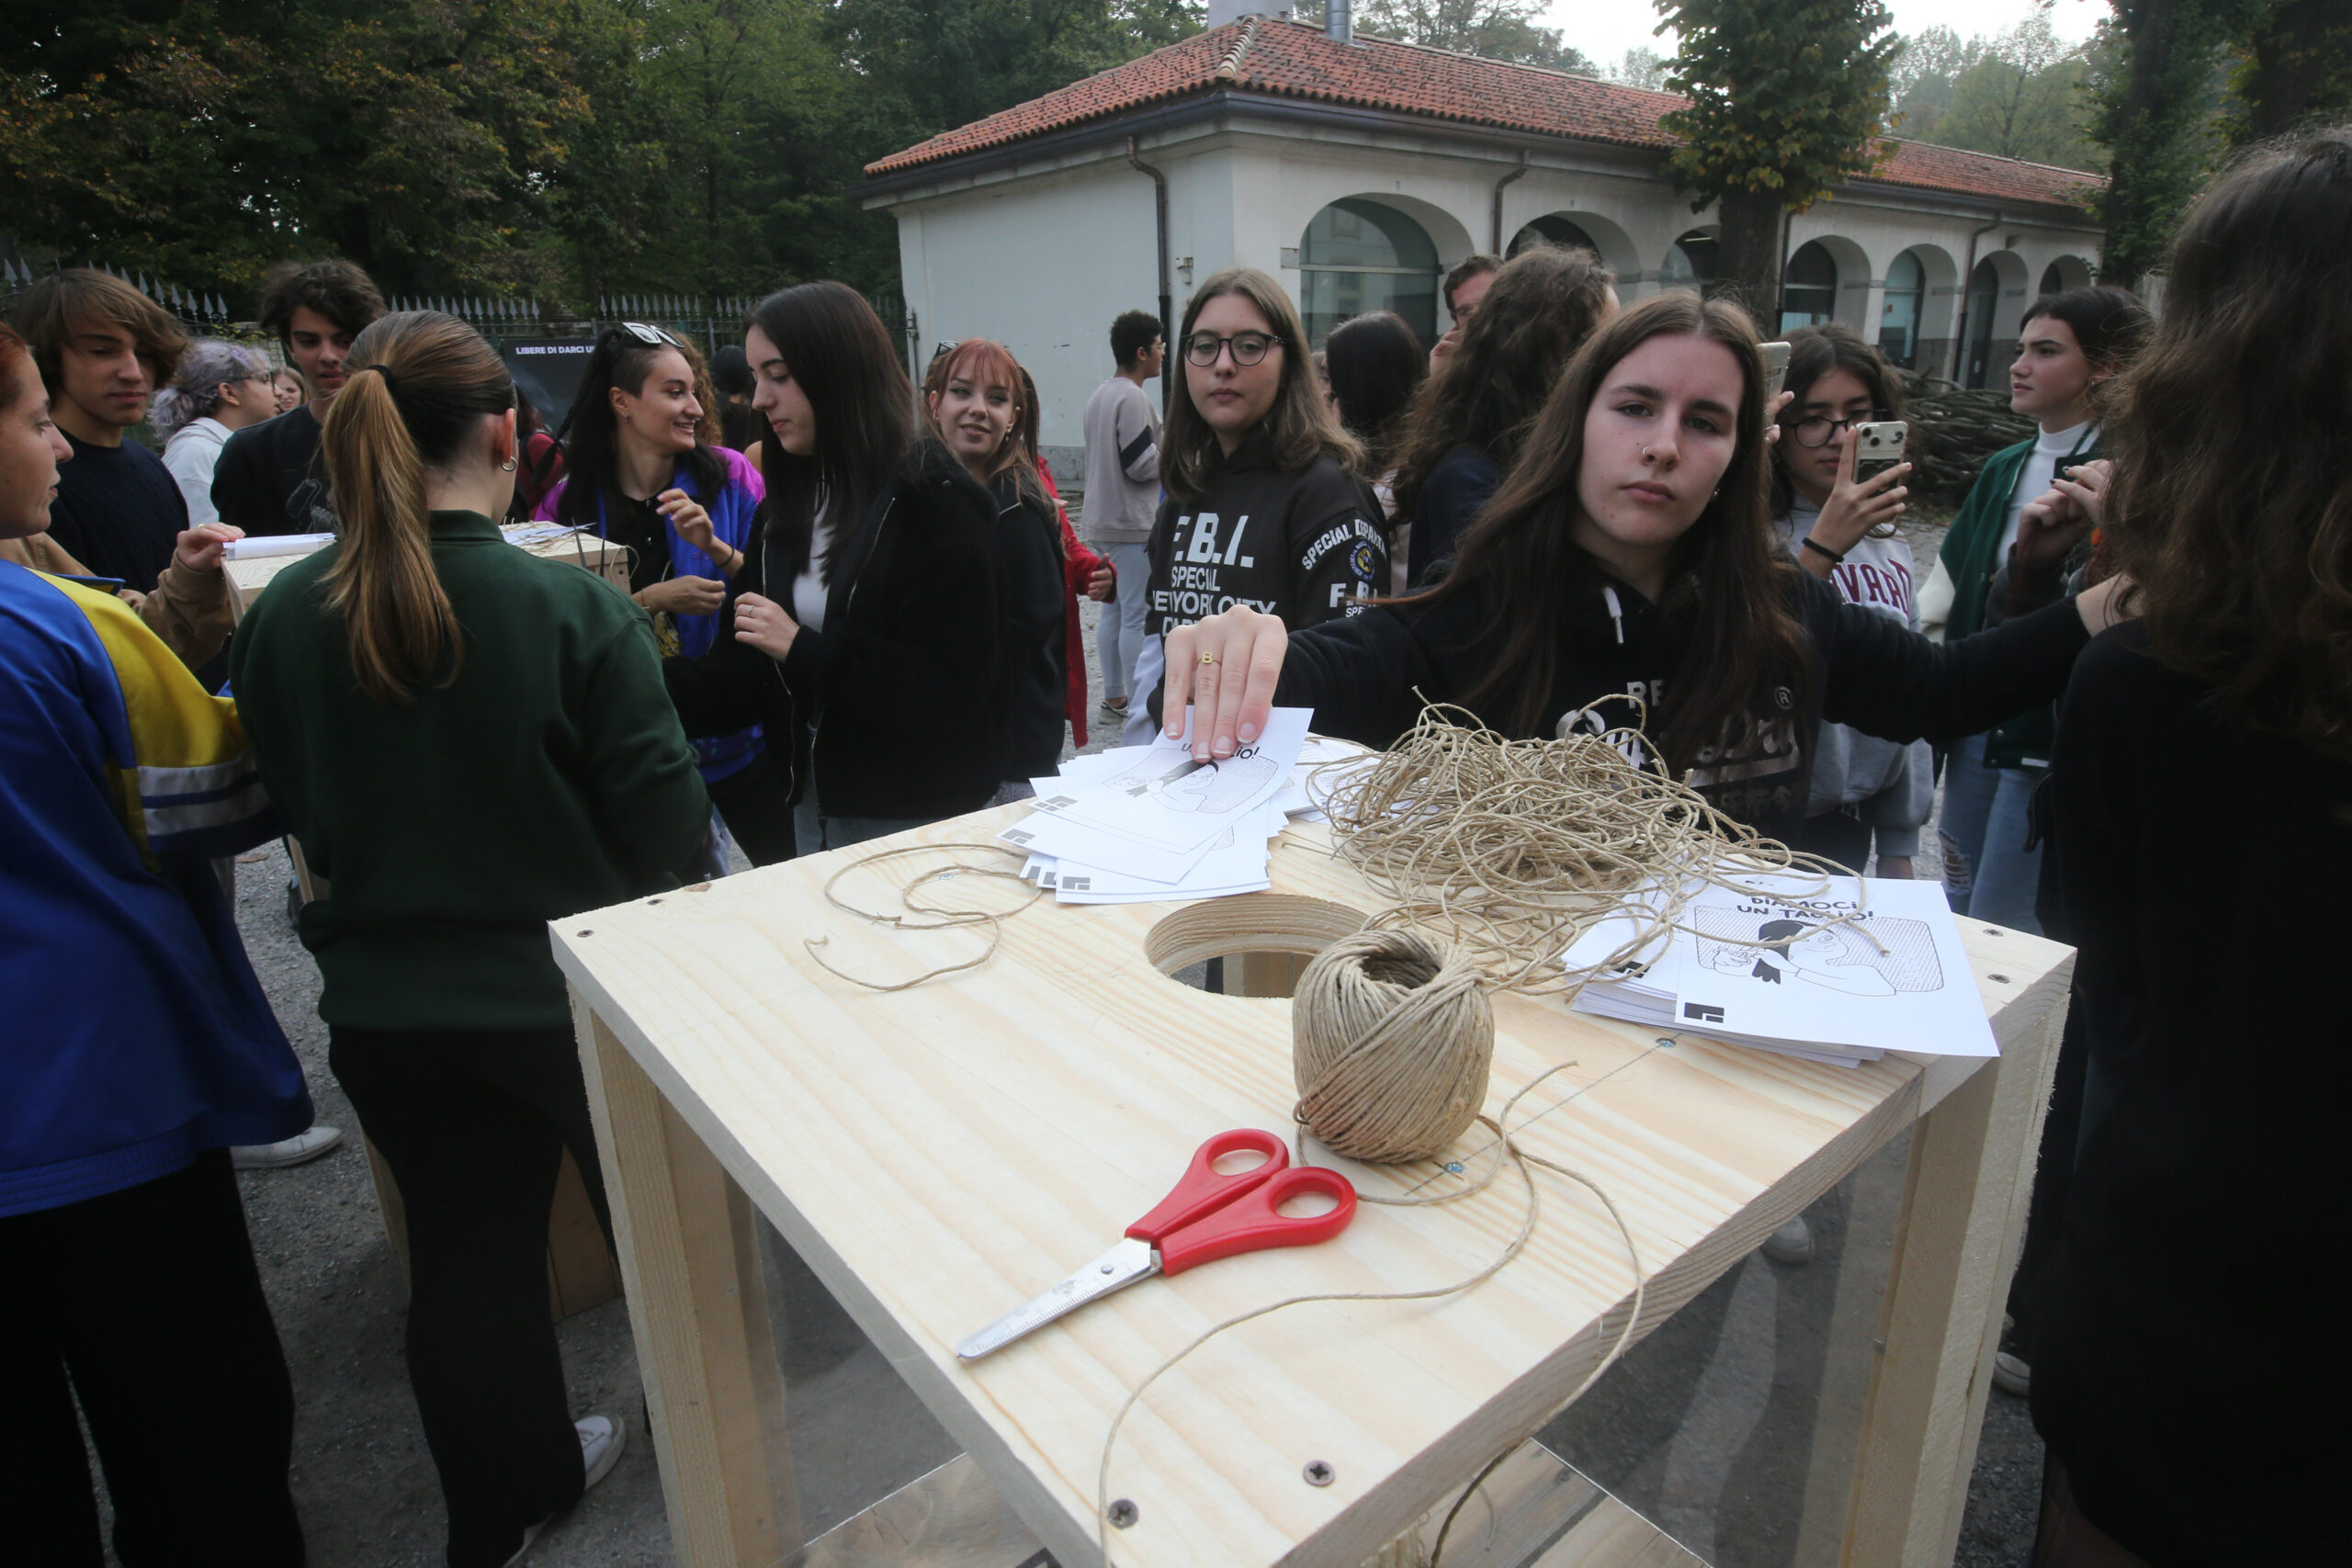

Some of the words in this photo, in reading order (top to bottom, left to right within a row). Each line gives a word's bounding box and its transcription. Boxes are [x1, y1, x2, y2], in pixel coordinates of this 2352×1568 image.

[515, 346, 546, 355] LIBERE
[558, 345, 584, 354] DARCI
[1302, 524, 1352, 570] SPECIAL
[1830, 558, 1912, 622] VARD
[1736, 905, 1769, 915] UN
